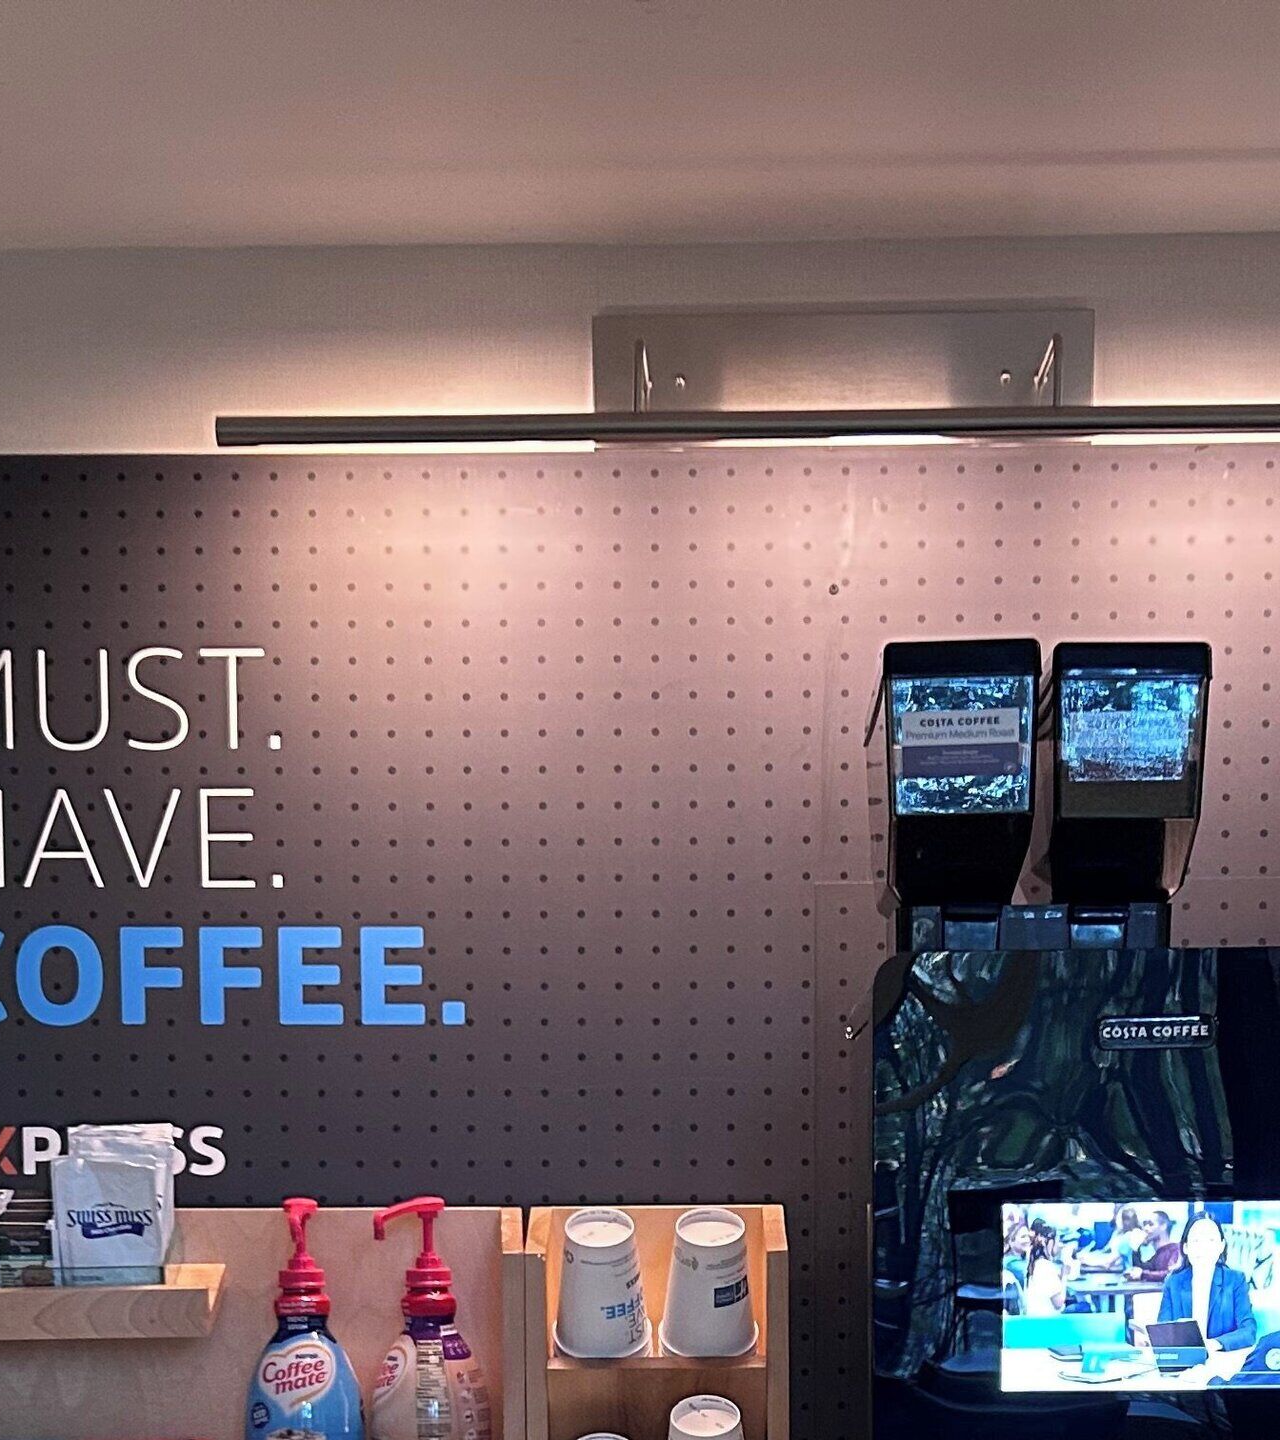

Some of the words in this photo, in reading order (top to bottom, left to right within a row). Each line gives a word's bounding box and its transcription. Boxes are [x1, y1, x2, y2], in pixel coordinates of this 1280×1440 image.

[920, 718, 954, 727] COSTA
[958, 716, 1000, 726] COFFEE
[905, 731, 948, 740] Premium
[949, 729, 987, 738] Medium
[989, 728, 1015, 737] Roast
[1102, 1025, 1147, 1039] COSTA
[1152, 1024, 1209, 1037] COFFEE
[263, 1360, 325, 1383] Coffee
[276, 1371, 328, 1395] mate
